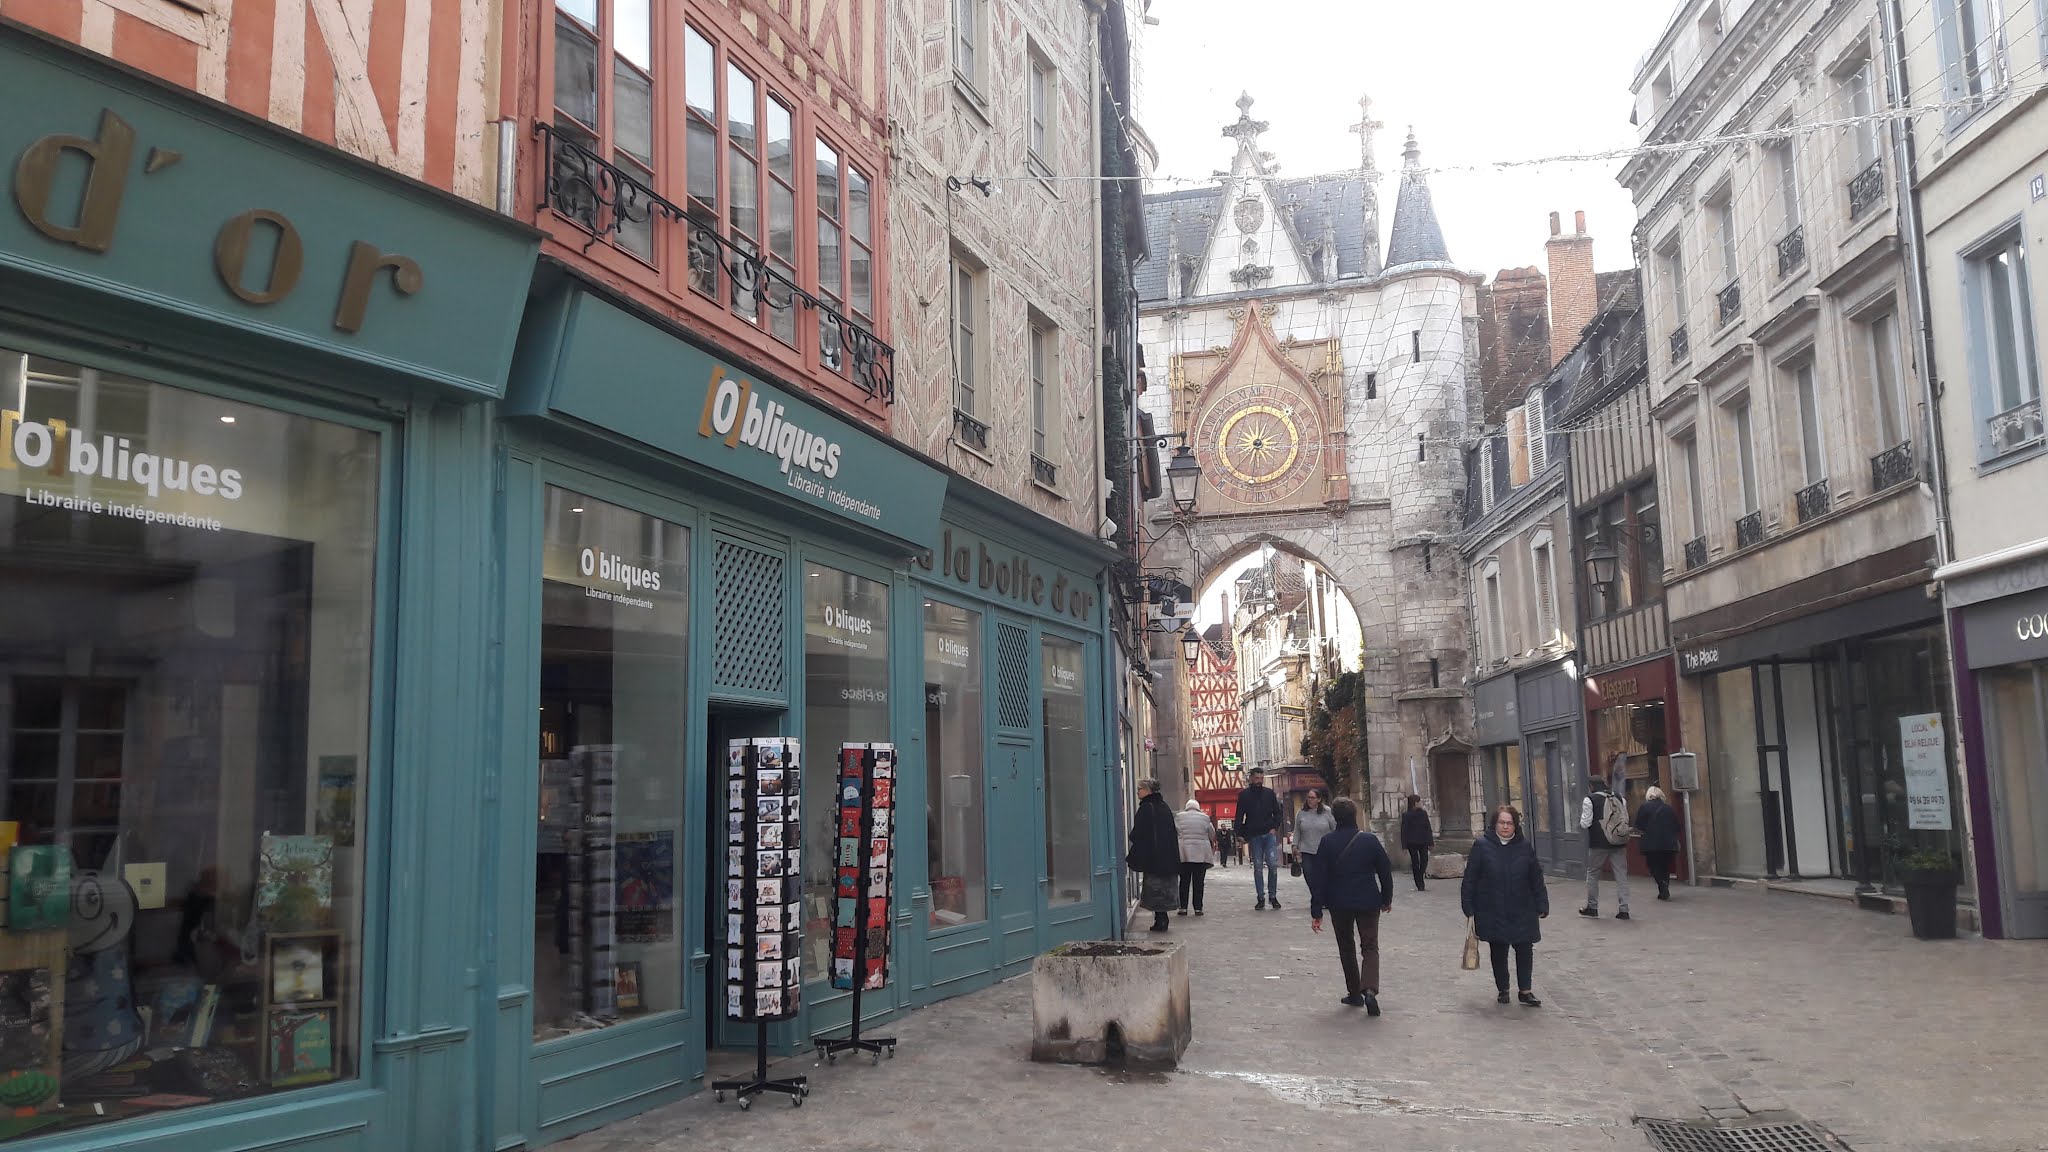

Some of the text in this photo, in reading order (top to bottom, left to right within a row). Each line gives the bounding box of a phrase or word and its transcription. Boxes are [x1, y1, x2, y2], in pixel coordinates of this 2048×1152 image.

[14, 107, 424, 334] d'or
[25, 487, 222, 532] Librairie indépendante
[787, 469, 881, 520] Librairie indépendante
[943, 528, 971, 582] la
[978, 542, 1045, 606] botte
[1052, 570, 1093, 621] d'or
[585, 586, 653, 609] Librairie indépendante
[1685, 647, 1719, 669] The Place
[1601, 678, 1638, 703] Eleganza
